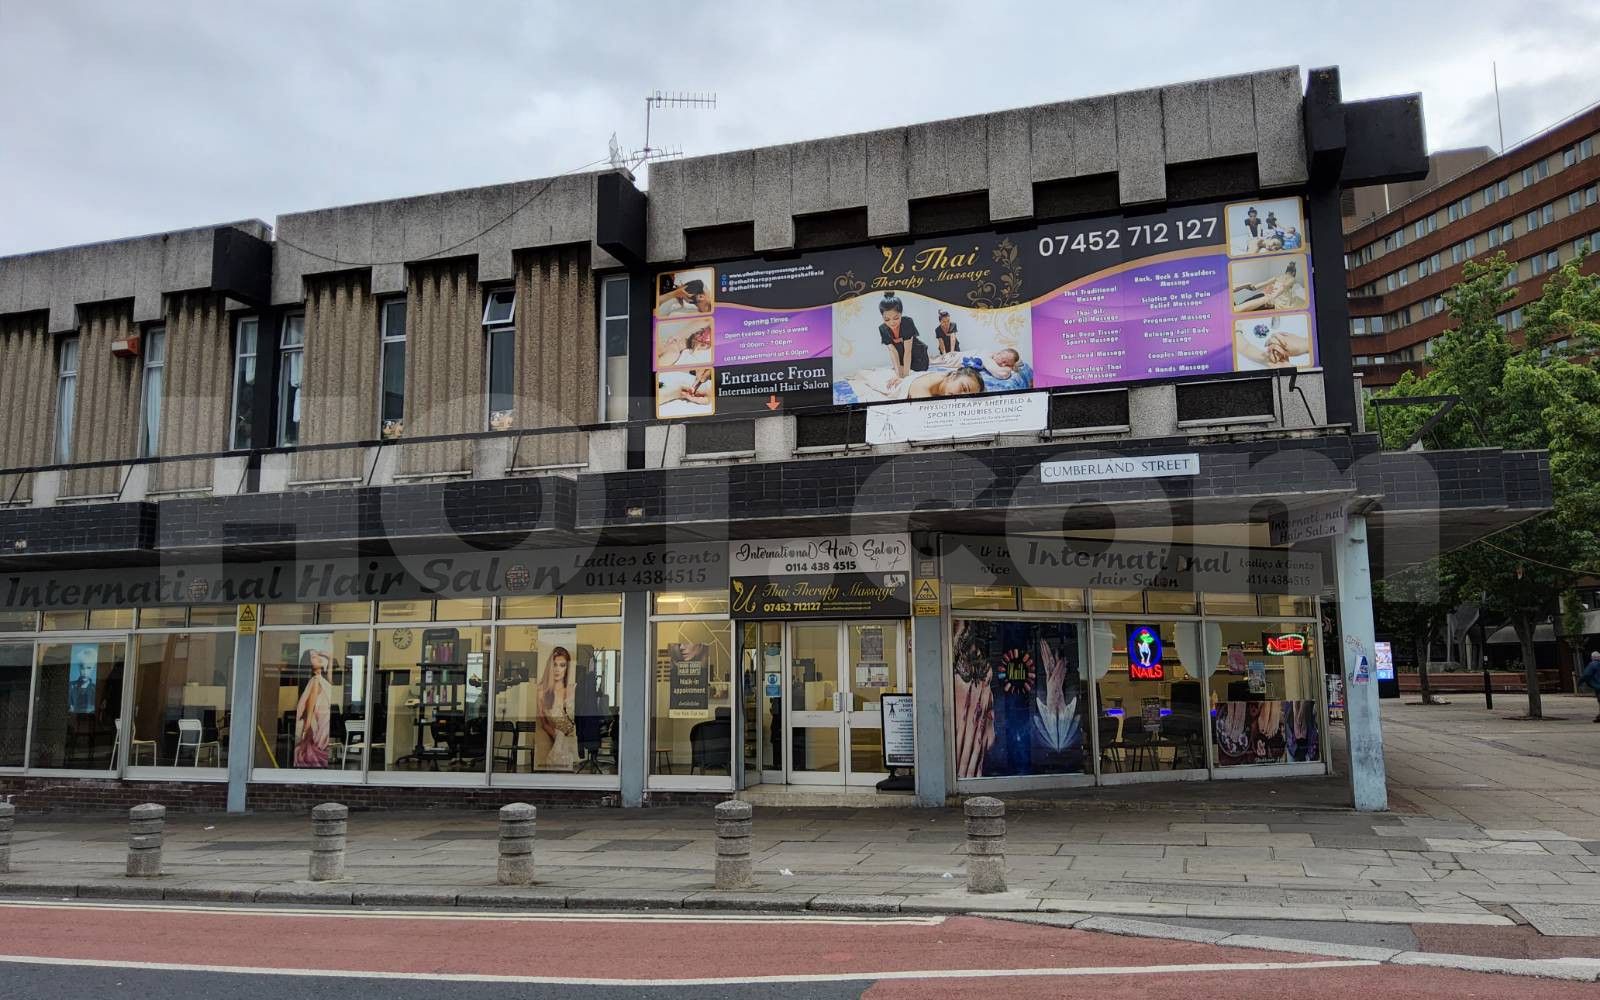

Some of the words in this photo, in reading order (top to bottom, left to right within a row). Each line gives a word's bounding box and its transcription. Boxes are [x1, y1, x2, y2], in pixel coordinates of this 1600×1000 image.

[1038, 229, 1120, 257] 07452
[1127, 223, 1168, 247] 712
[1176, 217, 1217, 241] 127
[912, 246, 979, 272] Thai
[871, 275, 924, 289] Therapy
[929, 269, 991, 283] Massage
[1155, 273, 1171, 281] Neck
[1182, 269, 1216, 278] Shoulders
[1081, 285, 1117, 295] Traditional
[1195, 290, 1211, 298] Pain
[743, 318, 769, 327] Opening
[721, 371, 785, 386] Entrance
[788, 366, 826, 380] From
[718, 384, 778, 397] International
[780, 382, 801, 392] Hair
[803, 380, 829, 390] Salon
[919, 401, 982, 412] PHYSIOTHERAPY
[984, 397, 1027, 408] SHEFFIELD
[928, 411, 956, 419] SPORTS
[958, 407, 993, 417] INJURIES
[994, 405, 1023, 415] CLINIC
[1043, 462, 1135, 477] CUMBERLAND
[1142, 458, 1190, 472] STREET
[1271, 506, 1344, 530] Internatinal
[1280, 530, 1303, 542] Hair
[735, 541, 818, 562] International
[818, 538, 859, 560] Hair
[863, 539, 907, 558] Salon
[1026, 541, 1233, 573] Internatinal
[573, 552, 637, 568] Ladies
[642, 551, 657, 566] &
[662, 549, 721, 565] Gents
[785, 562, 808, 572] 0114
[810, 562, 830, 571] 438
[832, 561, 856, 571] 4515
[1240, 558, 1273, 570] Ladies
[5, 566, 284, 607] International
[297, 560, 407, 598] Hair
[419, 556, 571, 594] Salon
[585, 571, 627, 587] 0114
[632, 568, 707, 586] 4384515
[1133, 572, 1179, 588] Salon
[761, 583, 790, 598] Thai
[792, 582, 840, 601] Therapy
[842, 581, 896, 601] Massage
[763, 603, 791, 612] 07452
[793, 602, 821, 611] 712127
[1267, 636, 1304, 651] Nails
[1131, 664, 1164, 679] NAILS
[673, 687, 706, 695] appointment
